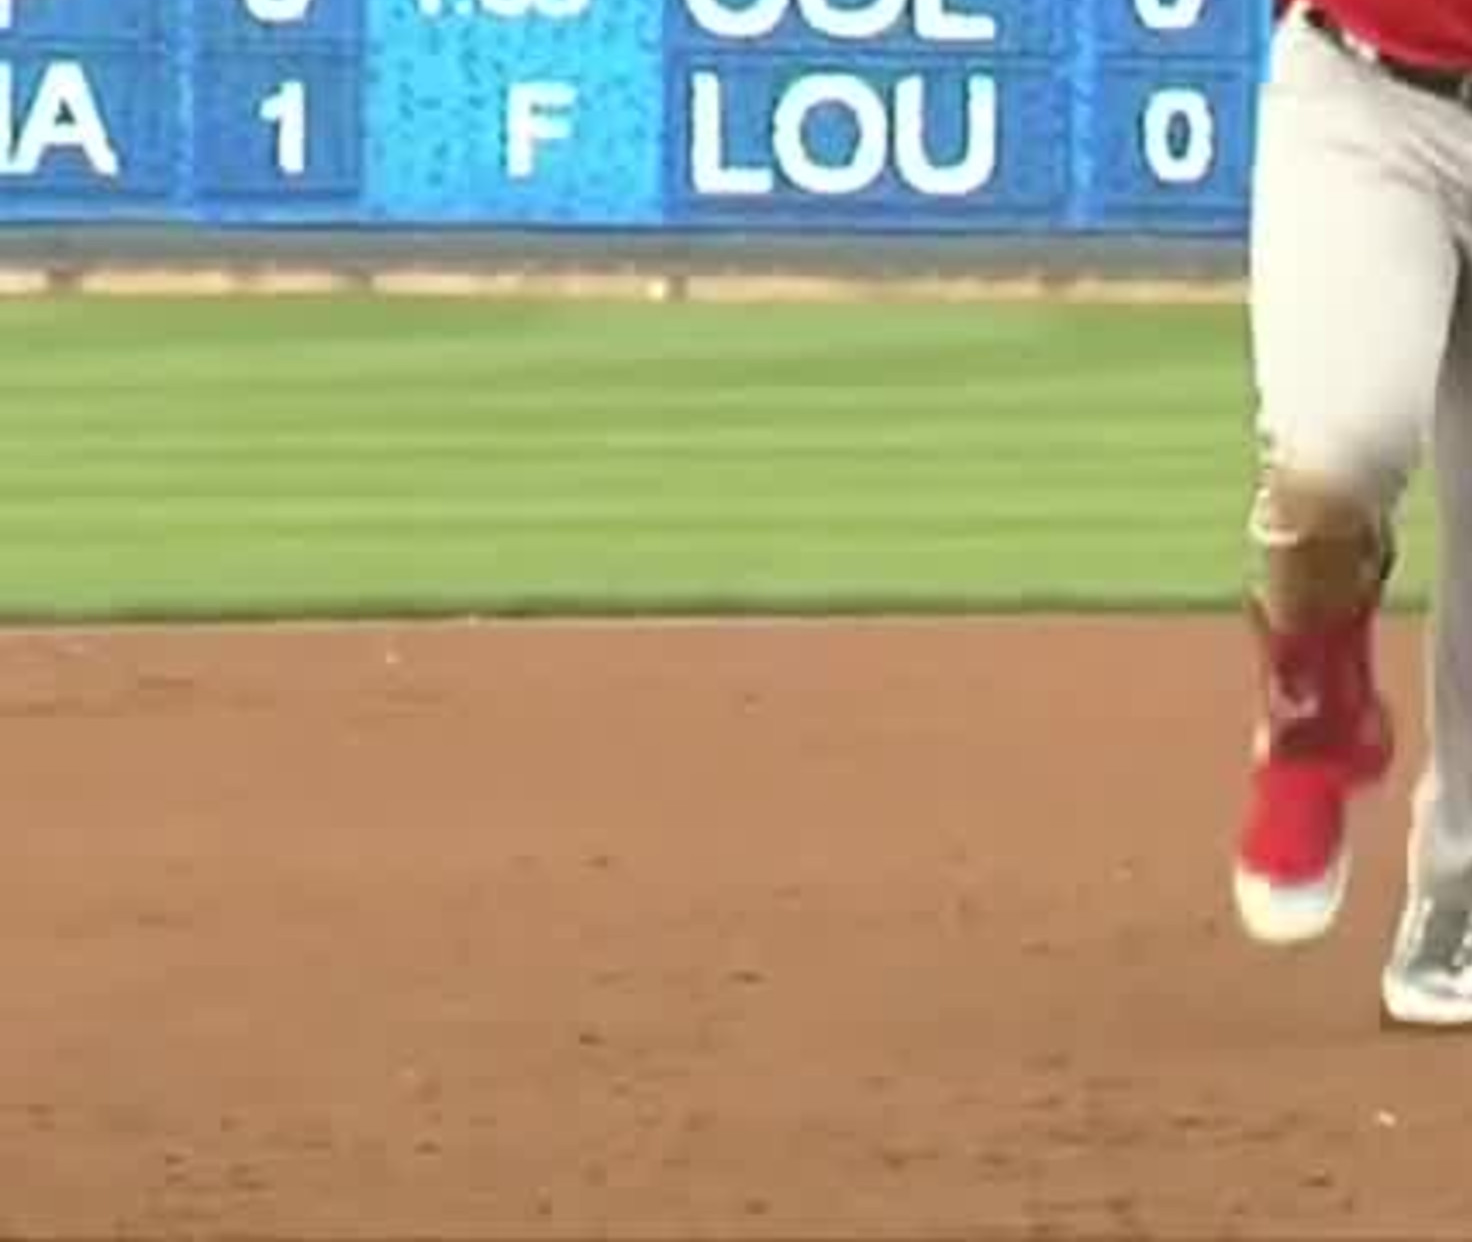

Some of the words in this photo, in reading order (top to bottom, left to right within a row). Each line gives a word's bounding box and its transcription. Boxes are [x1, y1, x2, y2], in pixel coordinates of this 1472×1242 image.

[0, 62, 118, 175] A
[261, 82, 305, 174] 1
[507, 83, 574, 177] F
[691, 73, 996, 196] LOU
[1144, 90, 1213, 182] 0
